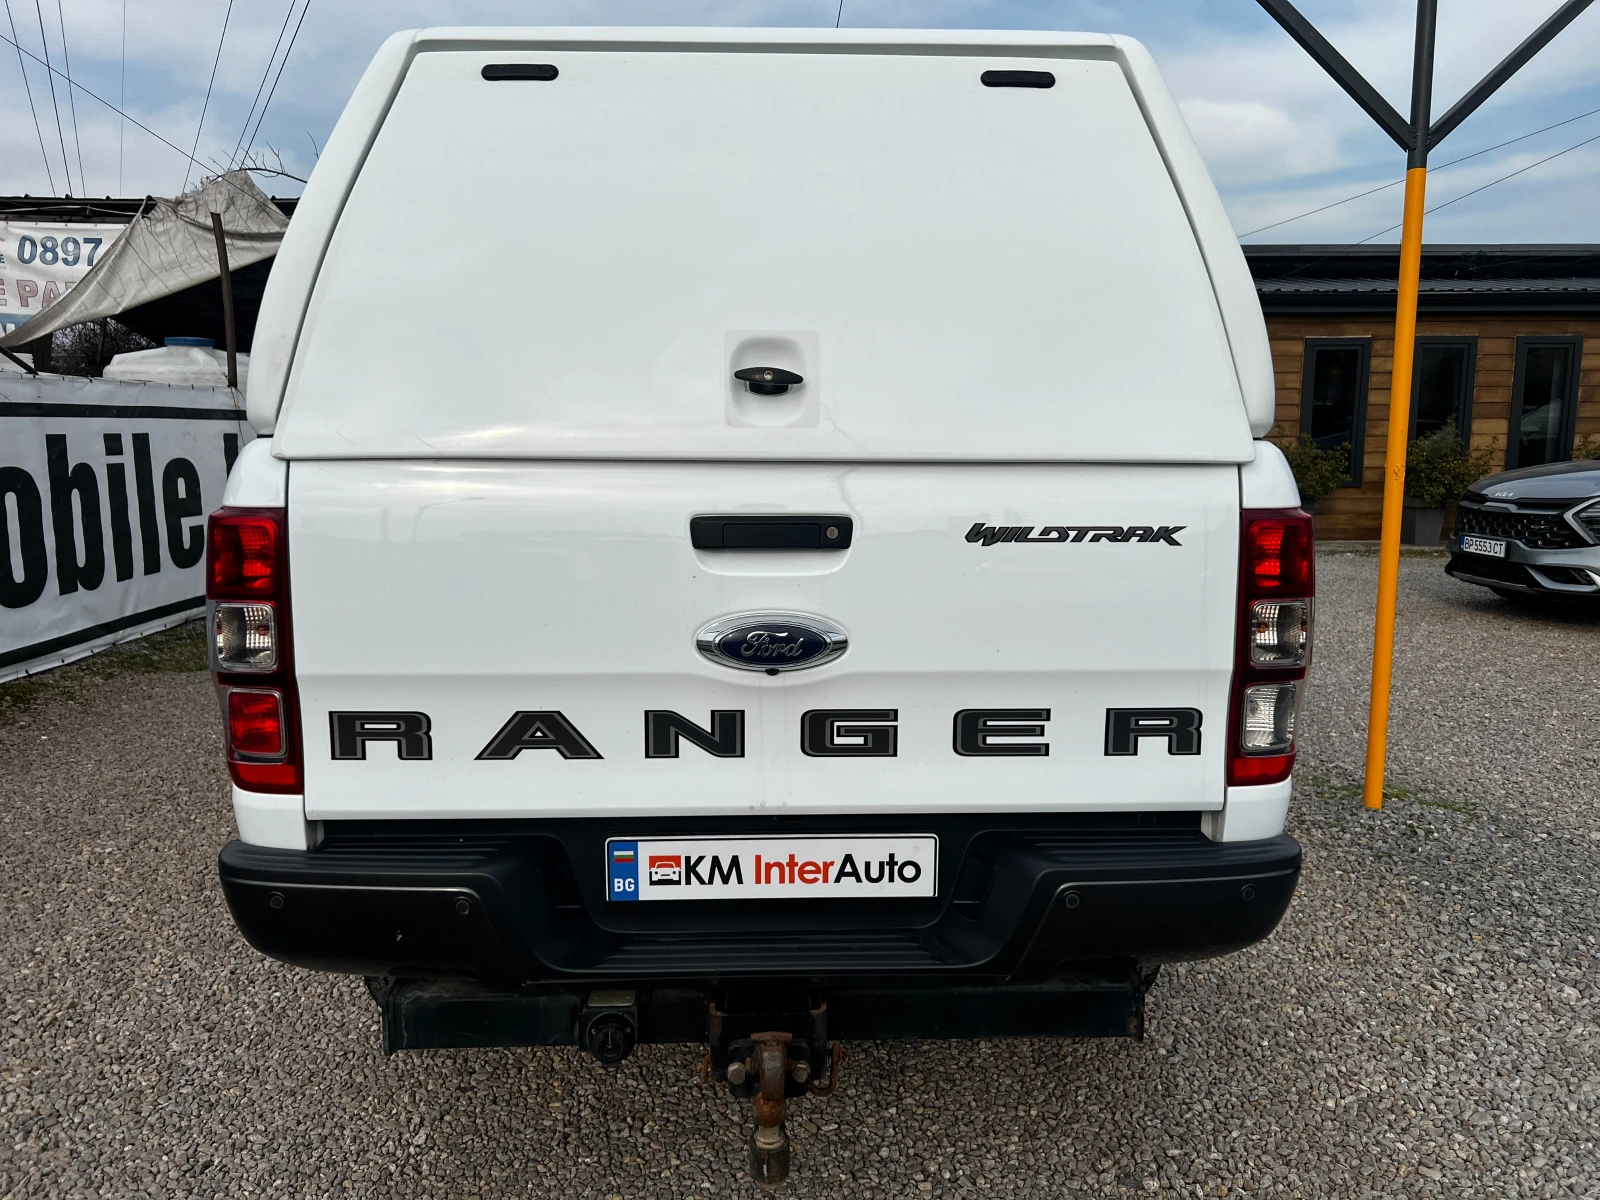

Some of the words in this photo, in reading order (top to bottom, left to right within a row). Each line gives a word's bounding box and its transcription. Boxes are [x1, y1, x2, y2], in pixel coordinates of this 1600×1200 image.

[17, 234, 103, 267] 0897
[964, 522, 1188, 547] WILDTRAK
[740, 630, 804, 658] Ford
[328, 707, 1204, 761] RANGER
[684, 854, 744, 886] KM
[754, 852, 922, 885] InterAuto
[614, 878, 635, 893] BG
